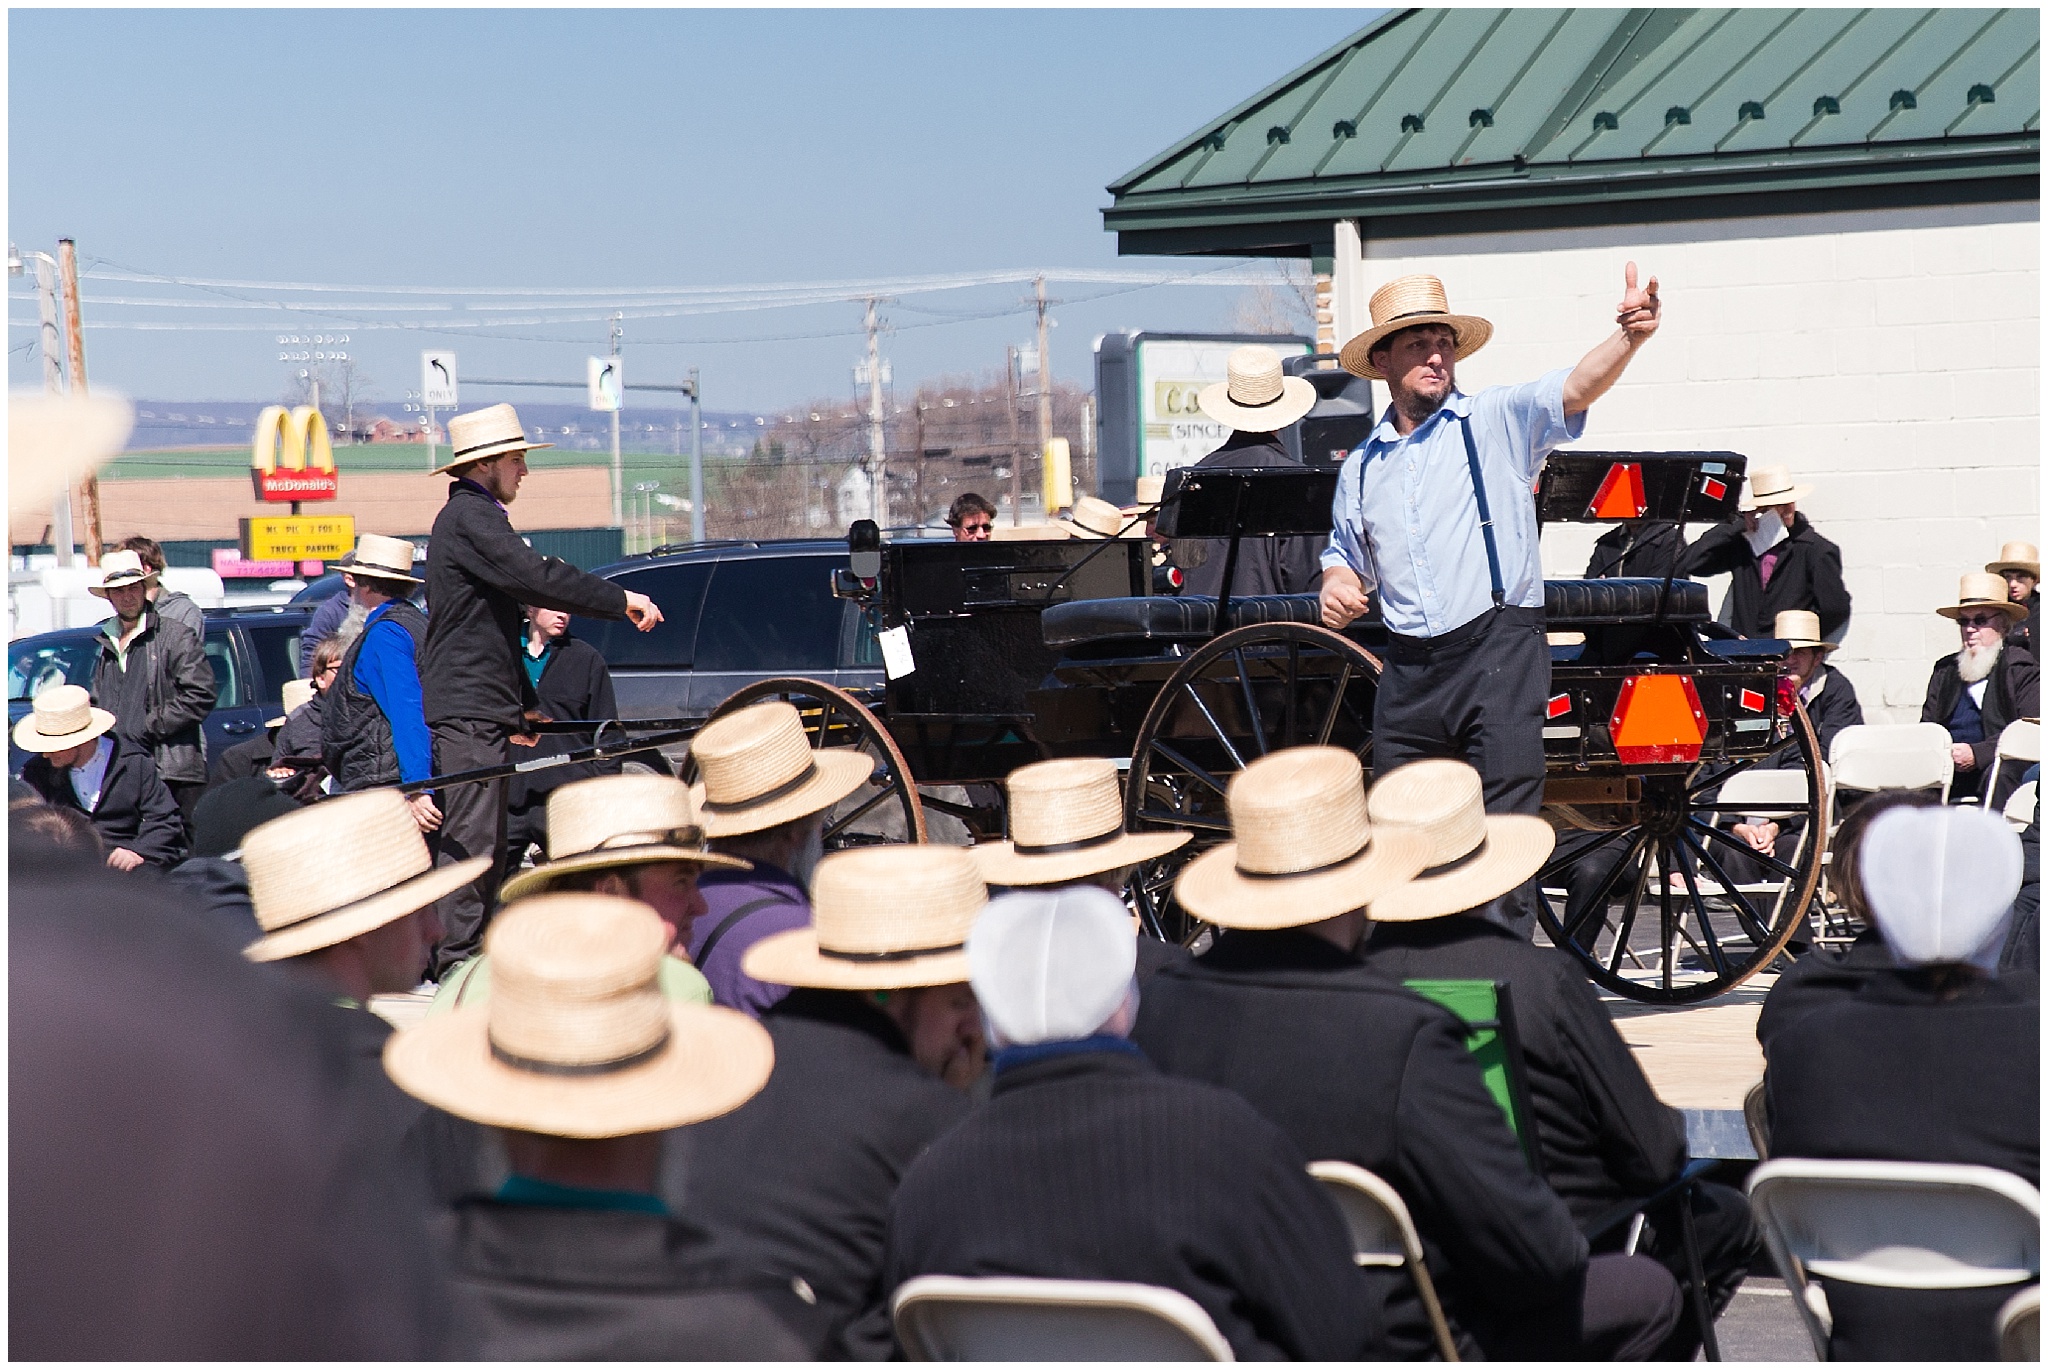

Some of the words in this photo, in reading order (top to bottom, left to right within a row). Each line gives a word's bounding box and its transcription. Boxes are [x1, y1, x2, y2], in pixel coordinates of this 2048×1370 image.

[429, 390, 454, 401] ONLY
[1176, 424, 1229, 439] SINCE
[266, 479, 336, 491] McDonald's
[271, 546, 298, 554] TRUCK
[306, 544, 341, 553] PARKING
